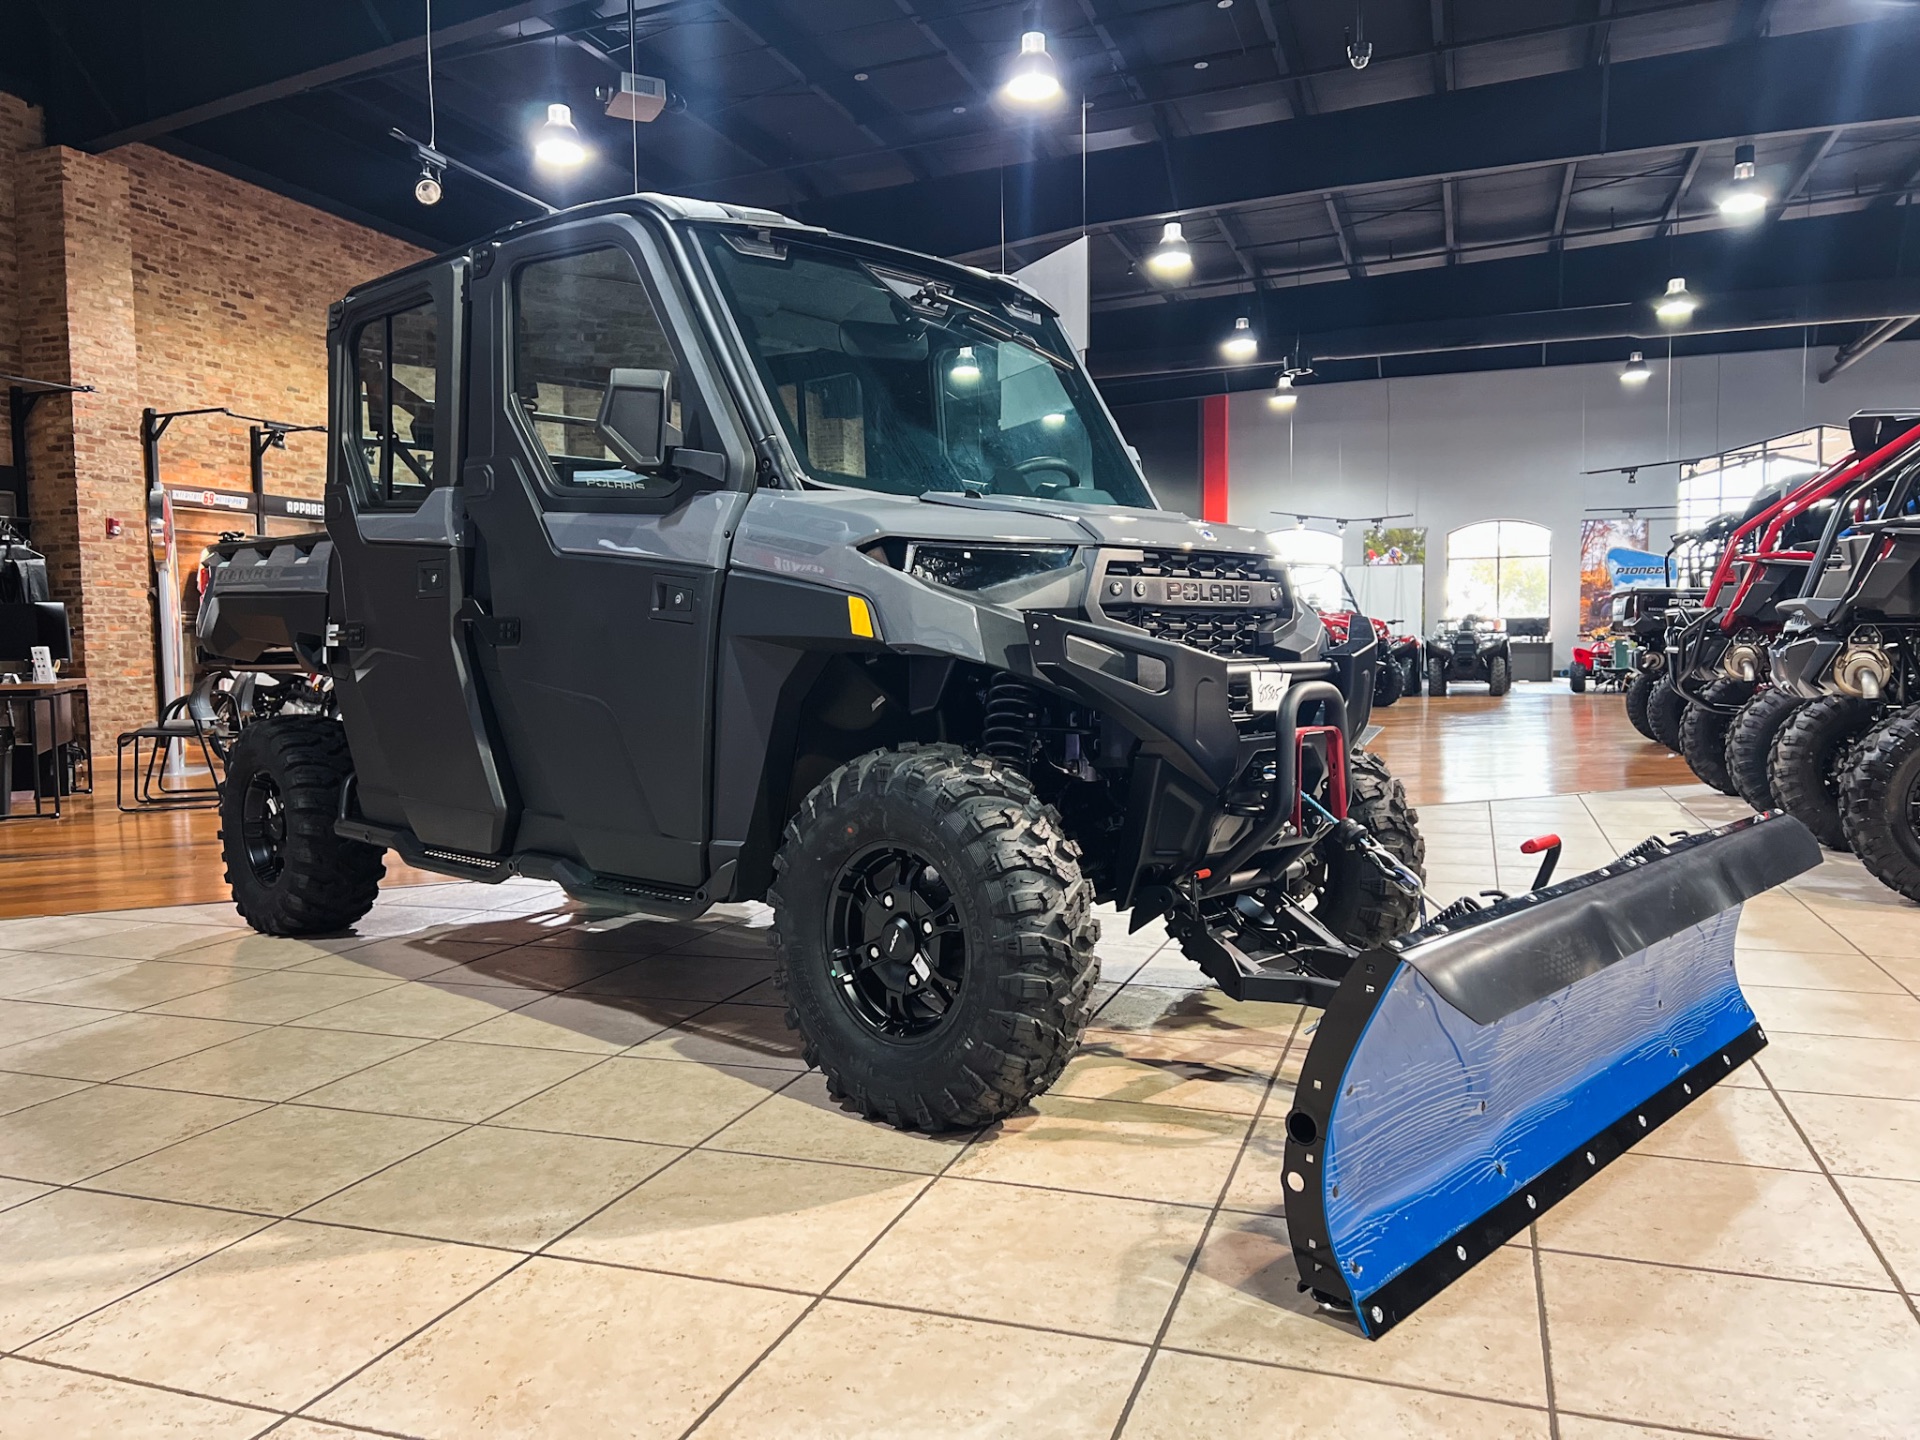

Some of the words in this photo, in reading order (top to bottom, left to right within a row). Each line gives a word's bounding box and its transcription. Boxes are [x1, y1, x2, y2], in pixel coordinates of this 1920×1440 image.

[586, 478, 646, 490] POLARIS
[203, 491, 215, 505] 69
[217, 566, 283, 580] RANGER
[1166, 582, 1251, 604] POLARIS
